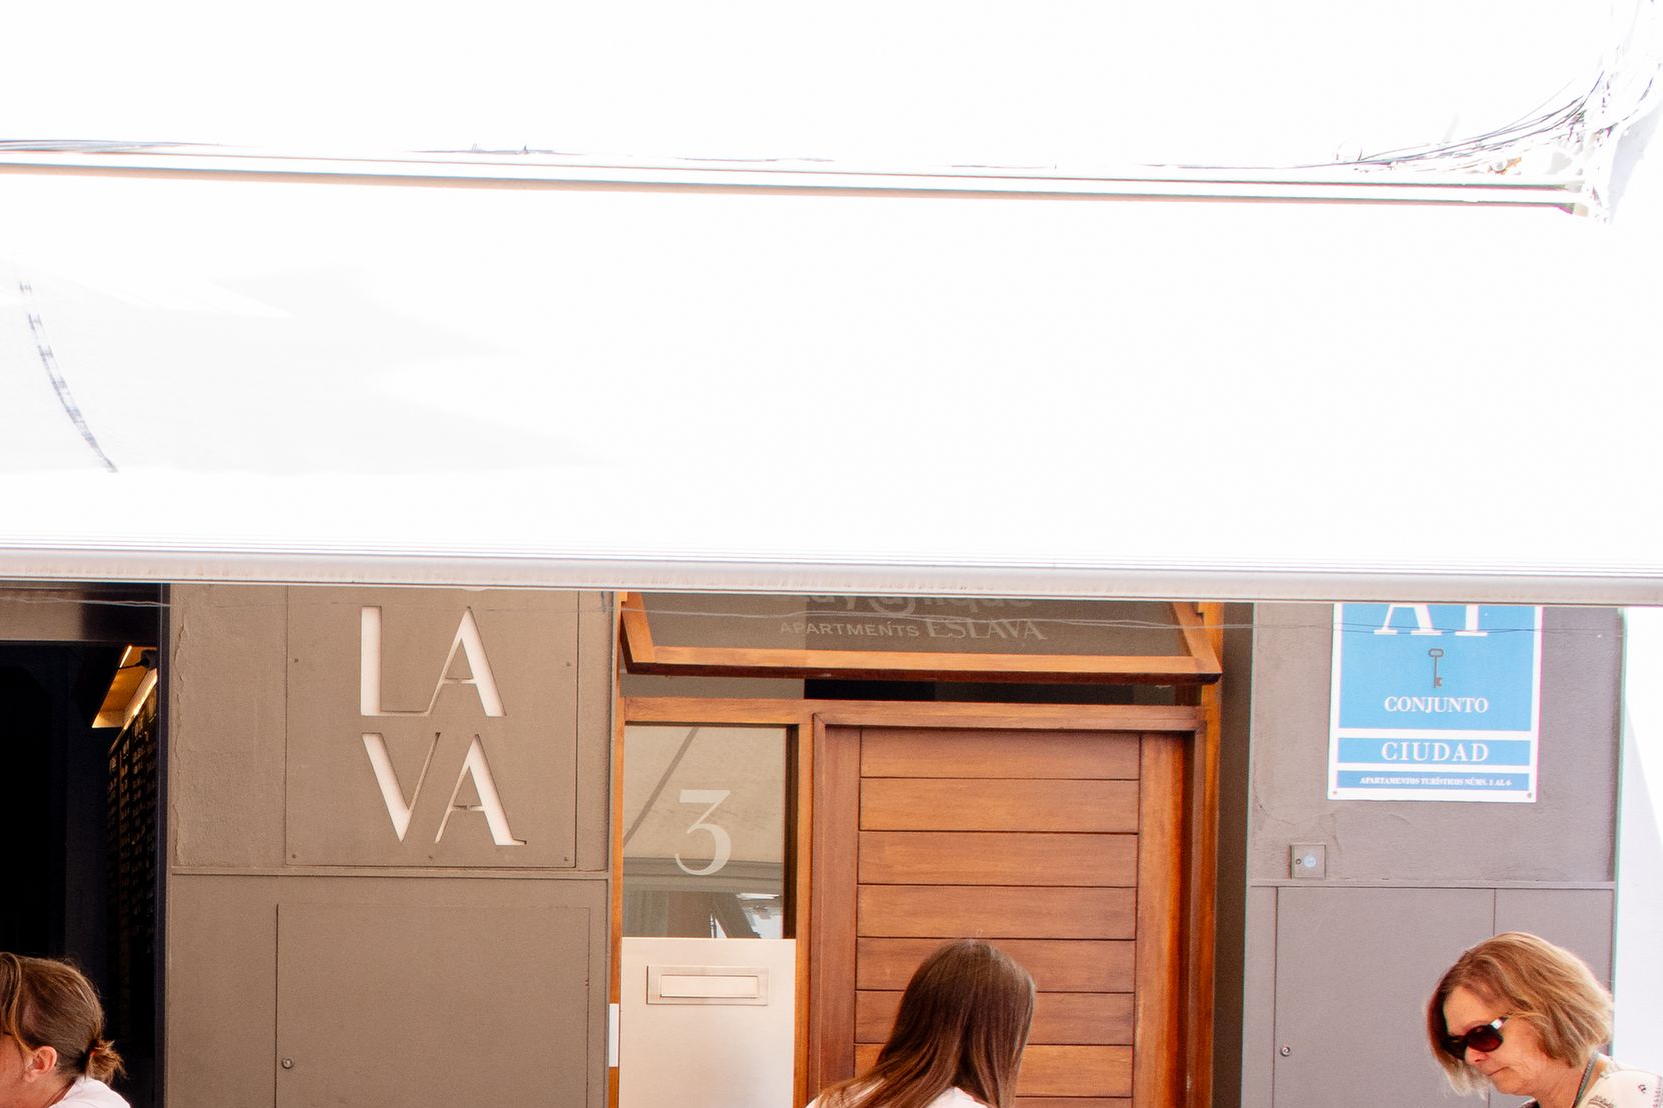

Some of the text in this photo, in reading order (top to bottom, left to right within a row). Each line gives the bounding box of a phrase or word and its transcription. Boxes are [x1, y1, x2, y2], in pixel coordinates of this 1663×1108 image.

[779, 617, 1048, 640] APARTMENTS ESLAVA
[360, 606, 507, 717] LA
[1384, 696, 1489, 713] CONJUNTO
[1381, 741, 1489, 762] CIUDAD
[362, 732, 527, 846] VA
[673, 788, 732, 876] 3
